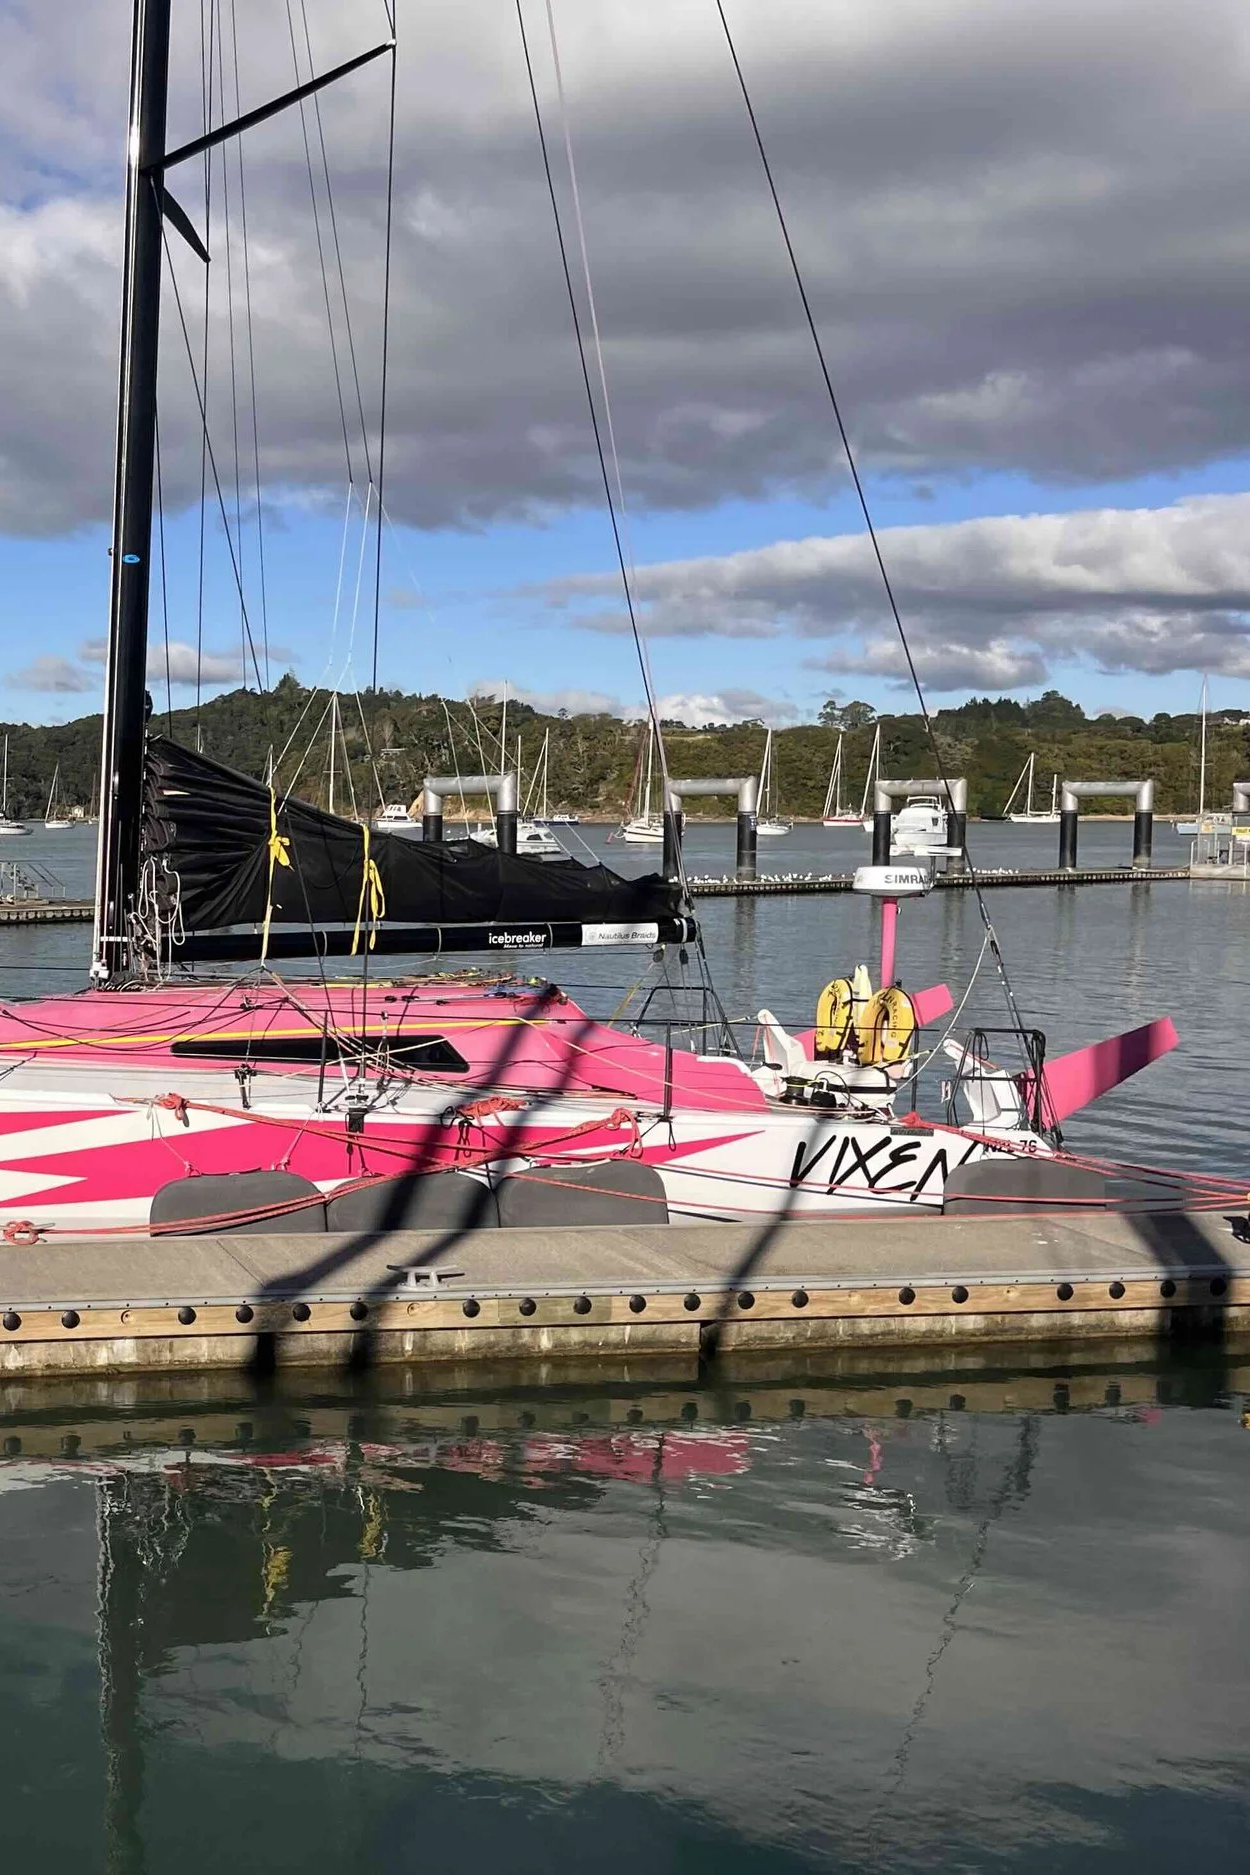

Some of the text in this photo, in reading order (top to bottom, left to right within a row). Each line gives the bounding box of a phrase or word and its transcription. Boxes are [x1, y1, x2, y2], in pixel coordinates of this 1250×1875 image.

[488, 931, 547, 944] icebreaker
[1019, 1139, 1038, 1153] 76
[789, 1134, 980, 1203] VIXEN
